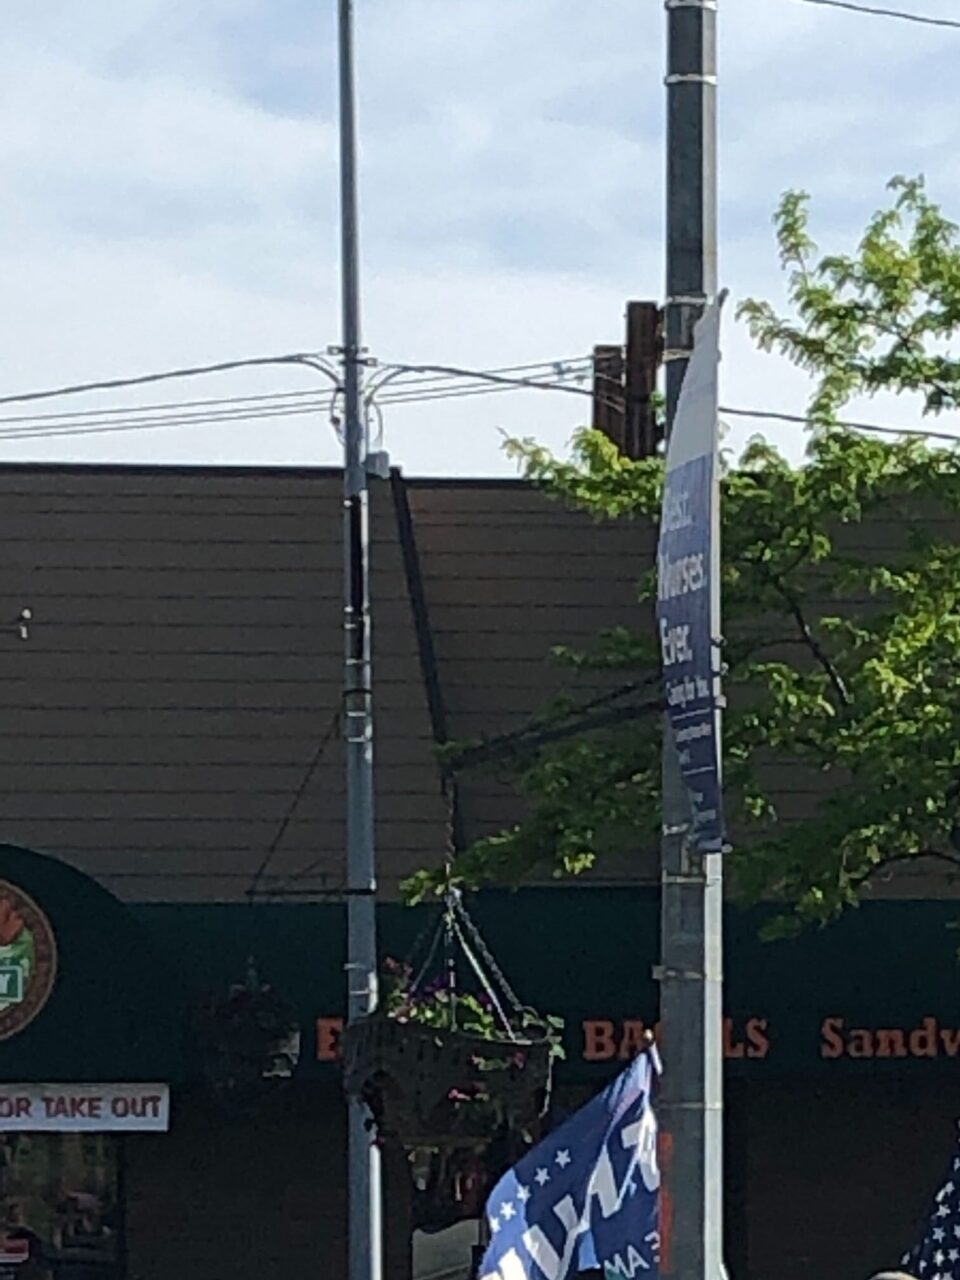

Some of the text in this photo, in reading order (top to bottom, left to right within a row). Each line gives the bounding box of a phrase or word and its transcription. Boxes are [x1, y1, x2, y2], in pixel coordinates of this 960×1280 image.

[582, 1017, 769, 1060] BALS
[42, 1095, 102, 1118] TAKE
[111, 1095, 161, 1118] OUT
